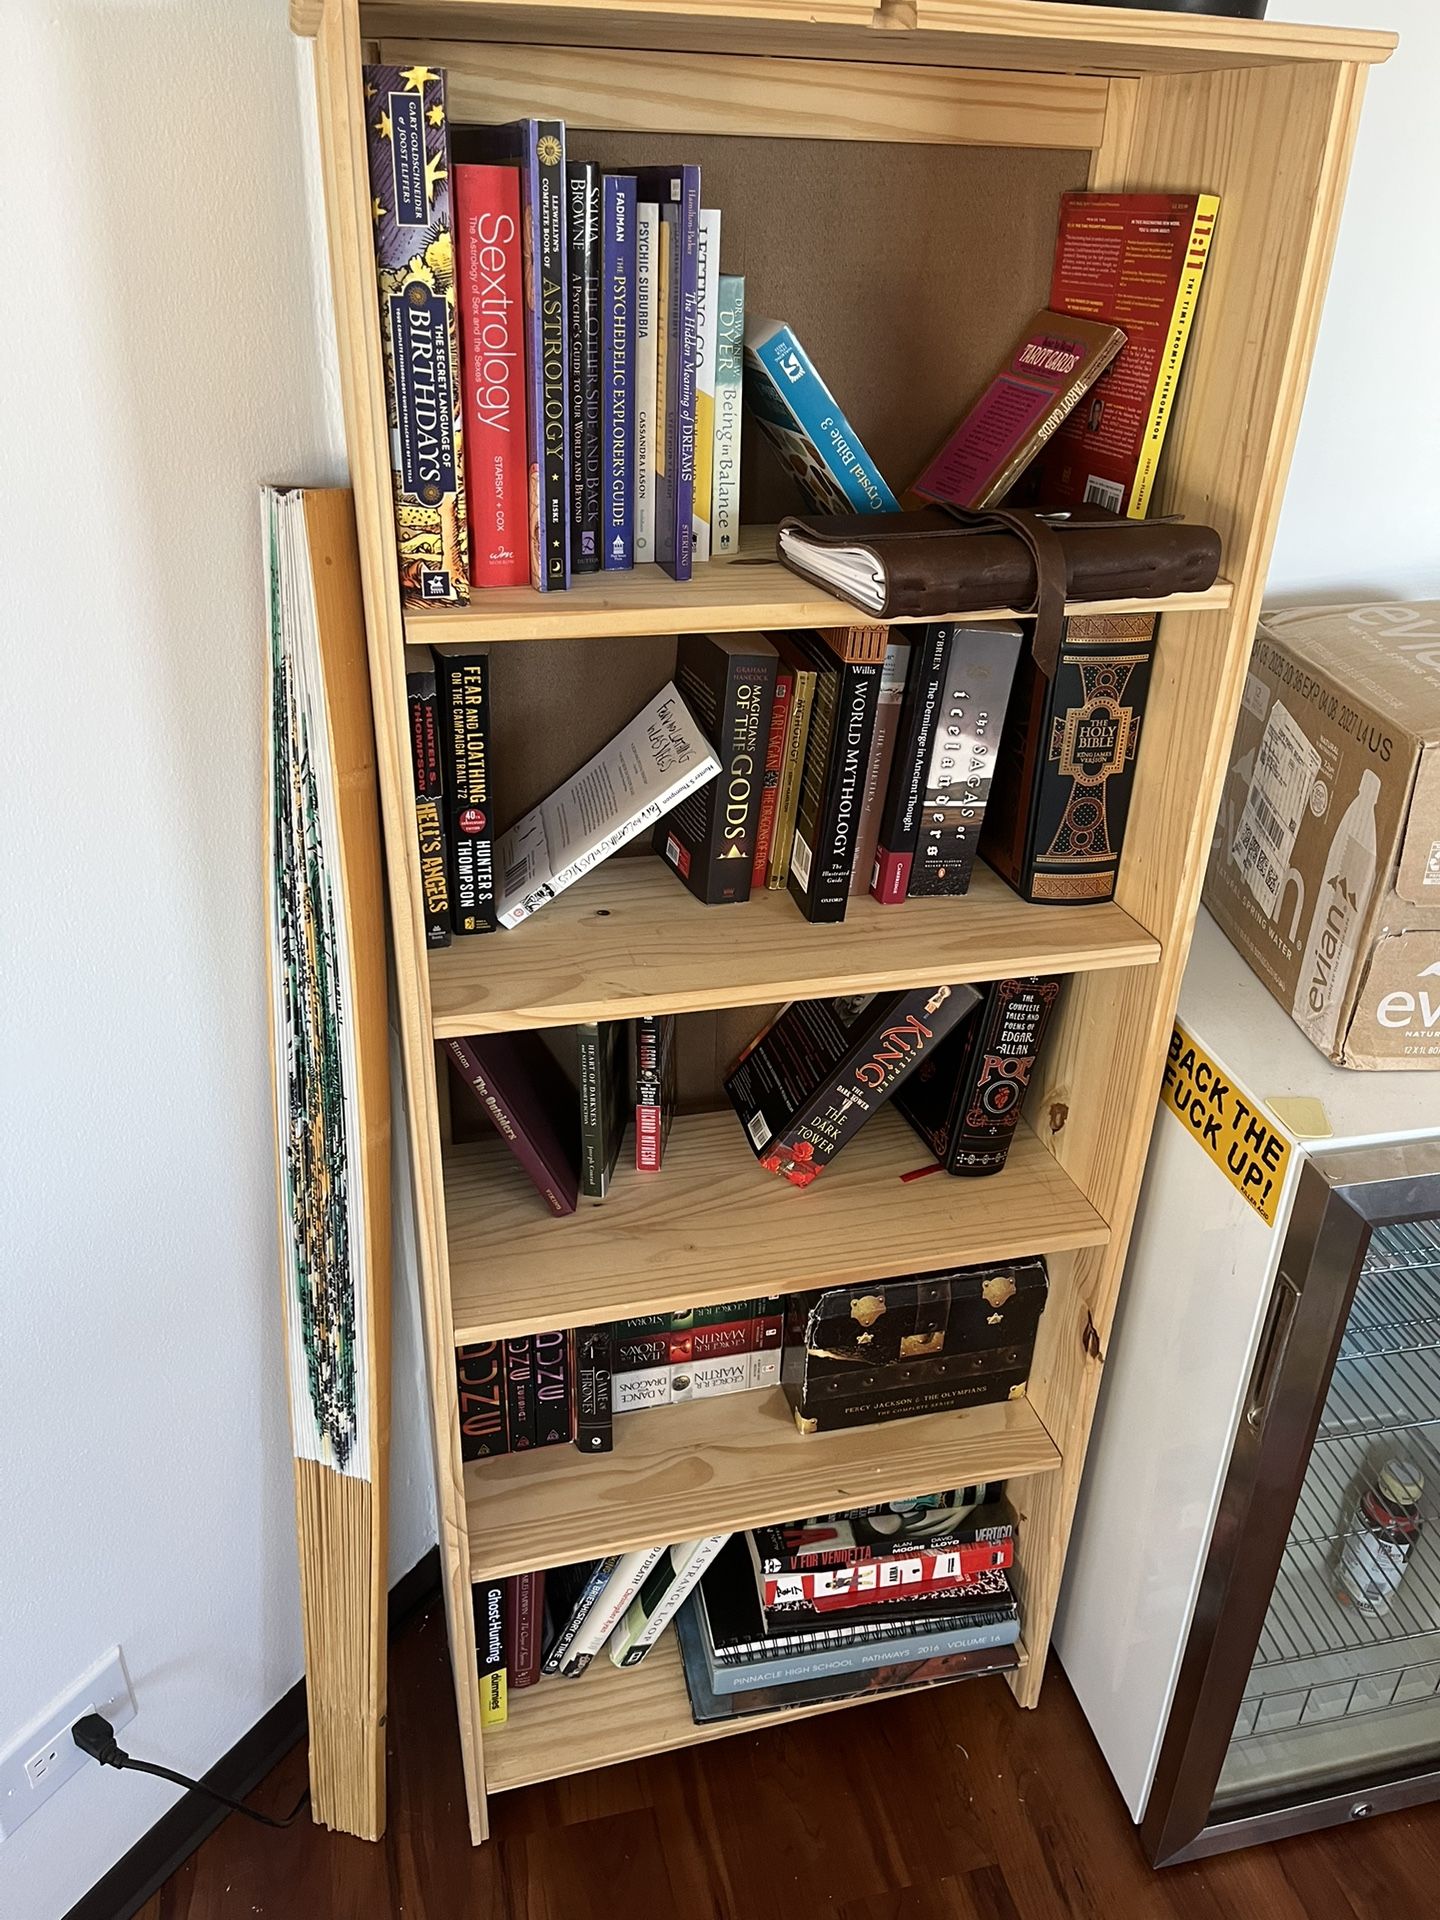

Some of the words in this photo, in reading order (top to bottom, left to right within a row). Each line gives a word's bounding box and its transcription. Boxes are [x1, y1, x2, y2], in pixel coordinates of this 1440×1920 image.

[408, 102, 418, 128] GARY
[398, 125, 409, 160] JOOST
[400, 161, 412, 202] ELFFERS
[410, 131, 423, 218] GOLDSCHNEIDER
[542, 178, 550, 225] COMPLETE
[570, 180, 586, 250] BROWNE
[616, 192, 625, 242] FADIMAN
[551, 195, 559, 253] LLEWELLYN'S
[687, 189, 697, 255] Hamilton-Parker
[1186, 213, 1214, 270] 11:11
[470, 236, 480, 282] Astrology
[616, 257, 624, 273] THE
[639, 221, 649, 273] PSYCHIC
[572, 286, 583, 338] PSYCHIC'S
[639, 278, 649, 338] SUBURBIA
[684, 292, 697, 312] The
[476, 213, 517, 432] Sextrology
[613, 276, 627, 386] PSYCHEDELIC
[684, 316, 697, 356] Hidden
[719, 308, 735, 373] DYER
[435, 348, 446, 391] SECRET
[543, 277, 563, 460] ASTROLOGY
[572, 341, 583, 377] GUIDE
[586, 317, 600, 384] OTHER
[1168, 330, 1182, 370] PROMPT
[408, 307, 440, 481] BIRTHDAYS
[680, 360, 695, 407] Meaning
[1060, 380, 1088, 414] TAROT
[438, 393, 450, 451] LANGUAGE
[573, 395, 584, 418] OUR
[586, 389, 600, 428] SIDE
[716, 390, 738, 442] Being
[819, 417, 834, 430] 3
[1038, 408, 1064, 441] CARDS
[1152, 375, 1171, 440] PHENOMENON
[574, 421, 584, 458] WORLD
[586, 433, 600, 472] AND
[613, 390, 625, 476] EXPLORER'S
[639, 412, 647, 468] CASSANDRA
[722, 445, 732, 456] in
[831, 430, 857, 466] Bible
[681, 425, 693, 481] DREAMS
[494, 455, 503, 499] STARSKY
[718, 460, 736, 528] Balance
[849, 464, 883, 510] Crystal
[575, 484, 584, 523] BEYOND
[586, 477, 600, 523] BACK
[612, 480, 625, 527] GUIDE
[496, 511, 505, 532] COX
[681, 524, 689, 567] STERLING
[851, 665, 876, 675] Willis
[932, 631, 946, 671] O'BRIEN
[451, 672, 462, 685] ON
[452, 688, 463, 706] THE
[464, 666, 482, 704] FEAR
[736, 684, 752, 710] OF
[927, 681, 939, 699] The
[453, 709, 465, 755] CAMPAIGN
[466, 708, 478, 729] AND
[731, 713, 749, 741] THE
[747, 684, 762, 752] MAGICIANS
[788, 699, 806, 764] MYTHOLOGY
[847, 682, 868, 745] WORLD
[917, 700, 935, 747] Demiurge
[1079, 726, 1117, 738] HOLY
[414, 703, 425, 791] THOMPSON
[425, 706, 436, 767] HUNTER
[1078, 737, 1114, 748] BIBLE
[1369, 728, 1393, 762] US
[456, 758, 467, 784] TRAIL
[467, 733, 486, 803] LOATHING
[867, 752, 883, 802] VARIETIES
[909, 759, 924, 798] Ancient
[961, 744, 988, 818] SAGAS
[662, 782, 690, 804] Thompson
[724, 754, 754, 840] GODS
[763, 789, 775, 804] THE
[833, 750, 860, 856] MYTHOLOGY
[416, 802, 441, 853] HELL'S
[758, 806, 772, 839] DRAGONS
[902, 796, 918, 834] Thought
[457, 839, 475, 907] THOMPSON
[477, 840, 493, 889] HUNTER
[753, 851, 767, 870] EDEN
[893, 863, 904, 894] CAMBRIDGE
[421, 857, 449, 913] ANGELS
[479, 893, 493, 905] S.
[1268, 928, 1292, 962] WATER
[1308, 904, 1345, 1013] evian
[1005, 1012, 1026, 1021] TALES
[1026, 1012, 1040, 1021] AND
[1008, 1003, 1040, 1012] COMPLETE
[1022, 994, 1034, 1002] THE
[1001, 1031, 1035, 1043] EDGAR
[1004, 1022, 1026, 1031] POEMS
[588, 1044, 596, 1071] HEART
[856, 1014, 934, 1088] KING
[996, 1044, 1029, 1055] ALLAN
[877, 1052, 918, 1096] STEPHEN
[977, 1054, 1036, 1087] POE
[450, 1040, 470, 1069] Hinton
[472, 1075, 489, 1097] The
[485, 1096, 517, 1141] Outsiders
[1169, 1030, 1229, 1115] BACK
[1232, 1099, 1284, 1173] THE
[810, 1116, 842, 1143] DARK
[826, 1105, 848, 1127] THE
[796, 1127, 835, 1157] TOWER
[1163, 1066, 1222, 1151] FUCK
[1227, 1141, 1273, 1206] UP!
[619, 1341, 666, 1356] CROWS
[694, 1327, 747, 1348] MARTIN
[580, 1369, 594, 1415] THRONES
[596, 1370, 611, 1402] GAME
[619, 1377, 667, 1392] DRAGONS
[694, 1365, 746, 1383] MARTIN
[712, 1375, 745, 1387] GEORGE
[621, 1393, 656, 1403] DANCE
[845, 1401, 872, 1414] PERCY
[873, 1397, 913, 1411] JACKSON
[923, 1395, 941, 1405] THE
[941, 1386, 988, 1401] OLYMPIANS
[893, 1405, 930, 1415] COMPLETE
[892, 1541, 913, 1549] ALAN
[892, 1545, 925, 1554] MOORE
[930, 1535, 954, 1543] DAVID
[930, 1539, 960, 1548] LLOYD
[975, 1524, 1012, 1542] VERTIGO
[632, 1560, 652, 1587] DEATH
[790, 1557, 799, 1569] V
[800, 1552, 820, 1568] FOR
[822, 1547, 873, 1567] VENDETTA
[667, 1557, 706, 1608] STRANGE
[486, 1589, 503, 1664] Ghost-Hunting
[569, 1606, 591, 1634] HISTORY
[644, 1612, 669, 1642] LOOP
[553, 1643, 571, 1661] TIME
[734, 1670, 781, 1689] PINNACLE
[784, 1666, 810, 1677] HIGH
[812, 1659, 854, 1672] SCHOOL
[861, 1650, 911, 1664] PATHWAYS
[917, 1644, 940, 1655] 2016
[947, 1637, 987, 1650] VOLUME
[491, 1673, 502, 1710] dummies
